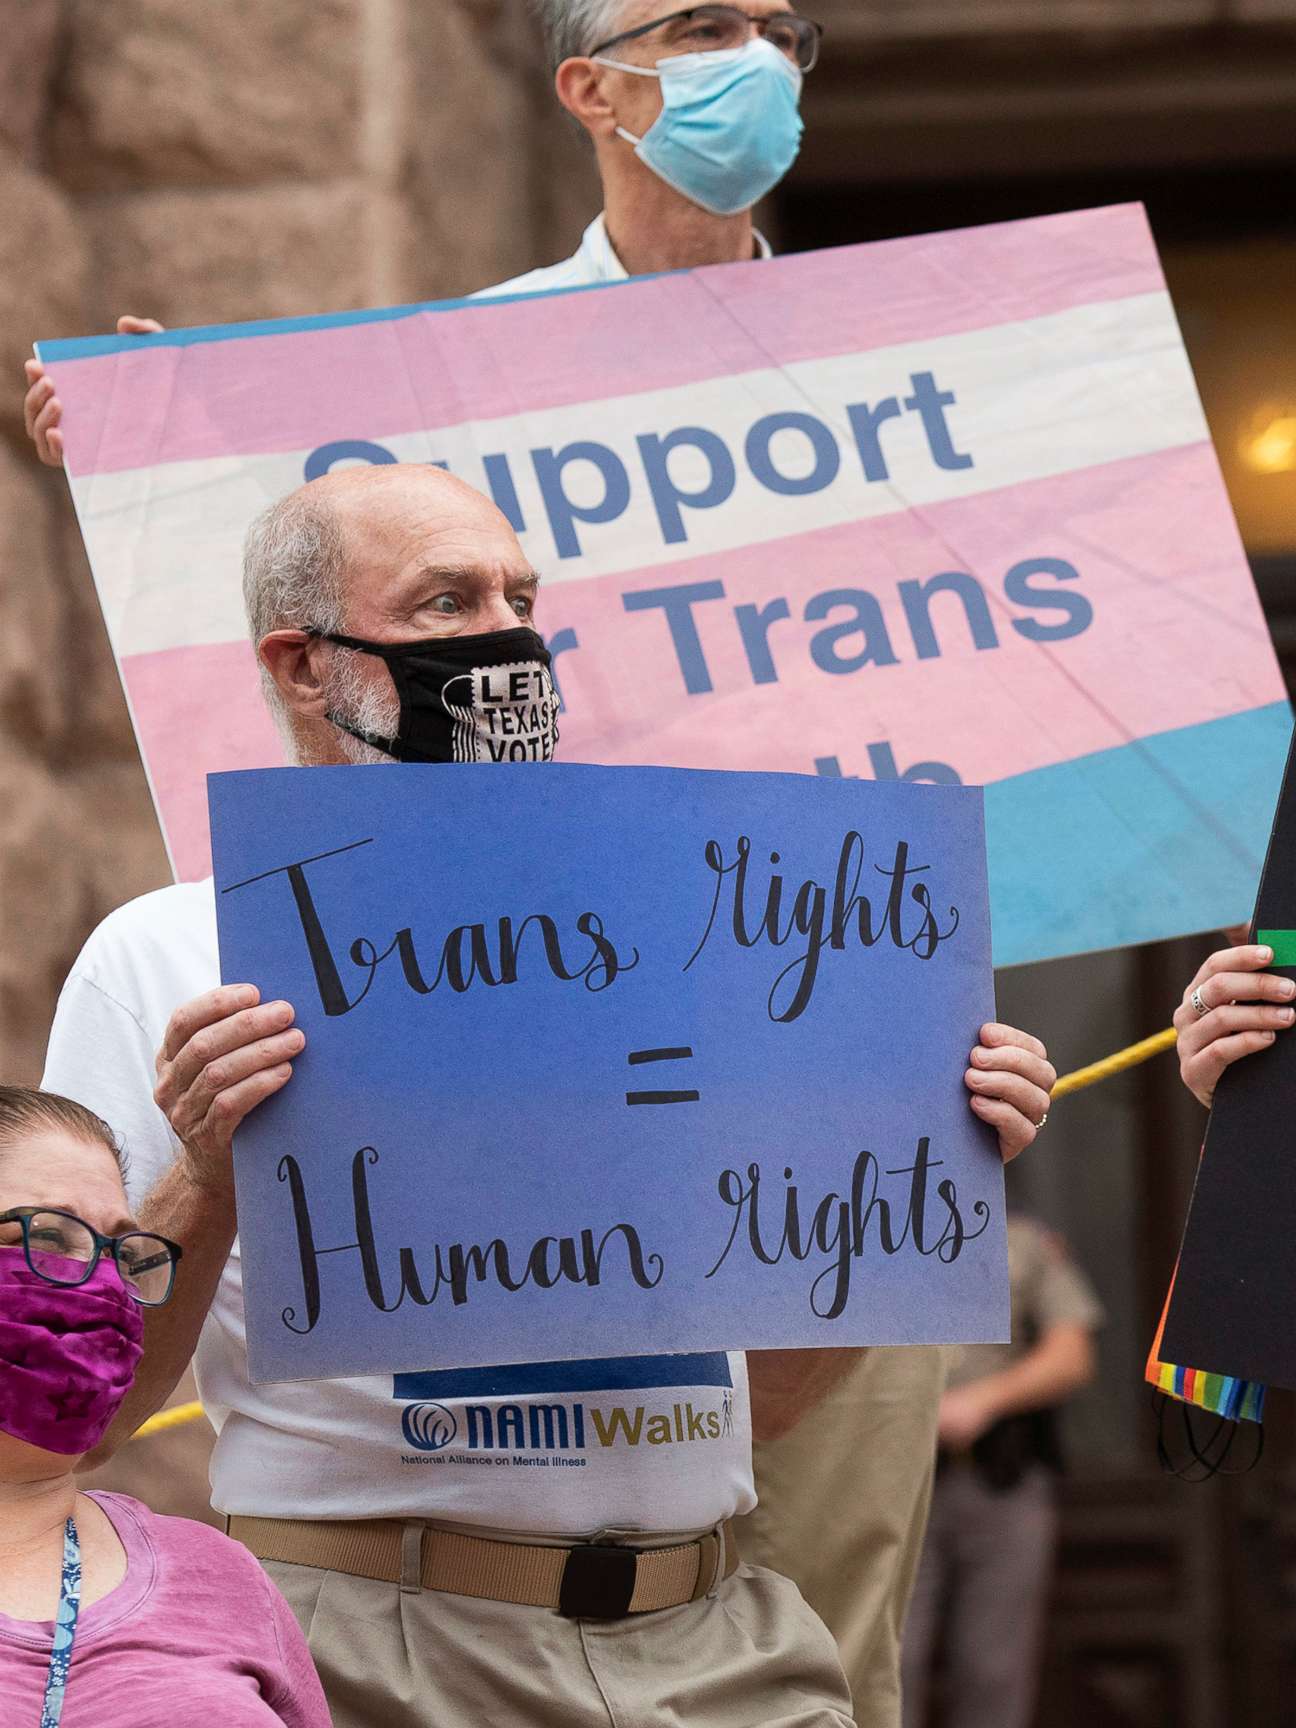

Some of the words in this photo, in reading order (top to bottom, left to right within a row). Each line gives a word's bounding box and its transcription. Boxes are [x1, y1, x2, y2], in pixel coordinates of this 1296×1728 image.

[621, 556, 1094, 696] Trans
[484, 700, 550, 735] TEXAS
[486, 732, 550, 762] VOTE
[222, 838, 639, 1017] Trans
[277, 1145, 664, 1334] Human
[401, 1455, 446, 1466] National
[449, 1455, 493, 1467] Alliance
[495, 1457, 509, 1467] on
[512, 1456, 550, 1467] Mental
[552, 1456, 587, 1468] Illness
